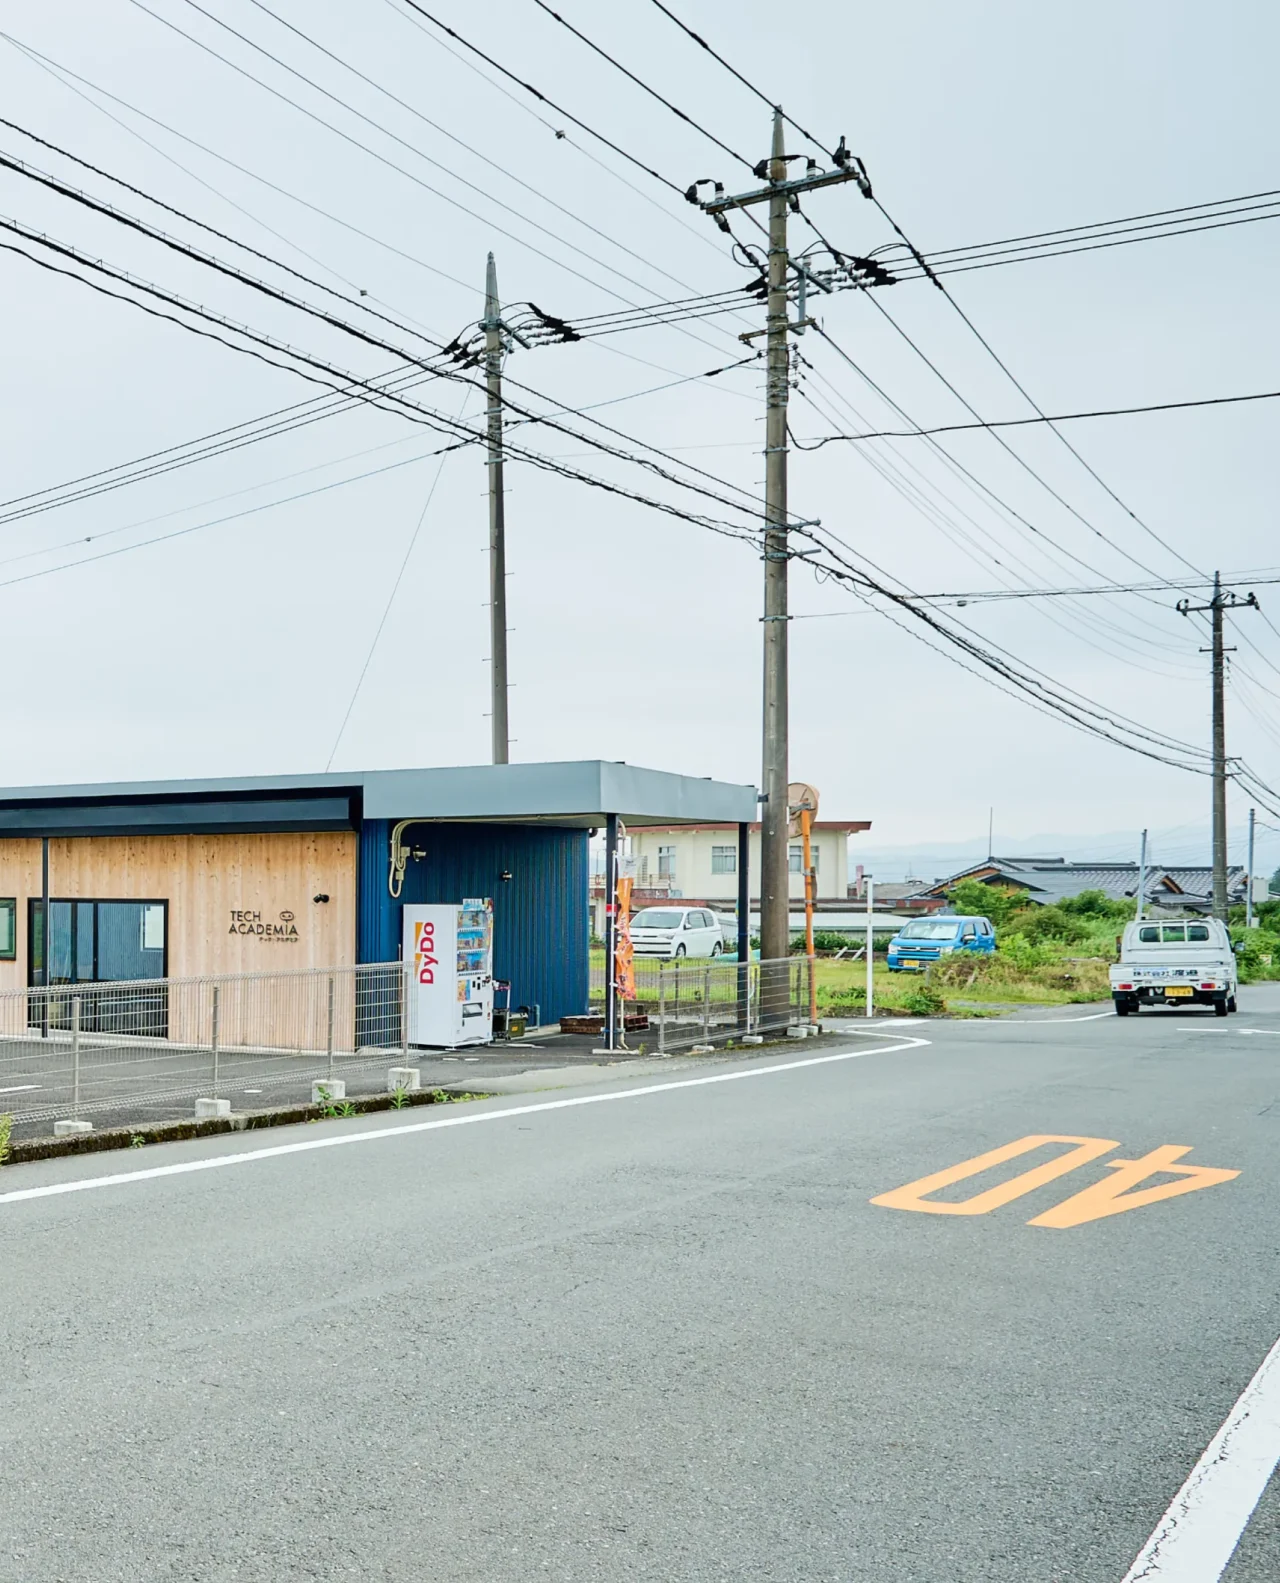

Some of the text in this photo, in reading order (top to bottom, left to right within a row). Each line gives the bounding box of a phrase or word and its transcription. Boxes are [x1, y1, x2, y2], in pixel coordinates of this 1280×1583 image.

[228, 923, 299, 936] ACADEMIA
[230, 910, 261, 922] TECH
[420, 922, 438, 984] DyDo
[869, 1134, 1243, 1229] 40
